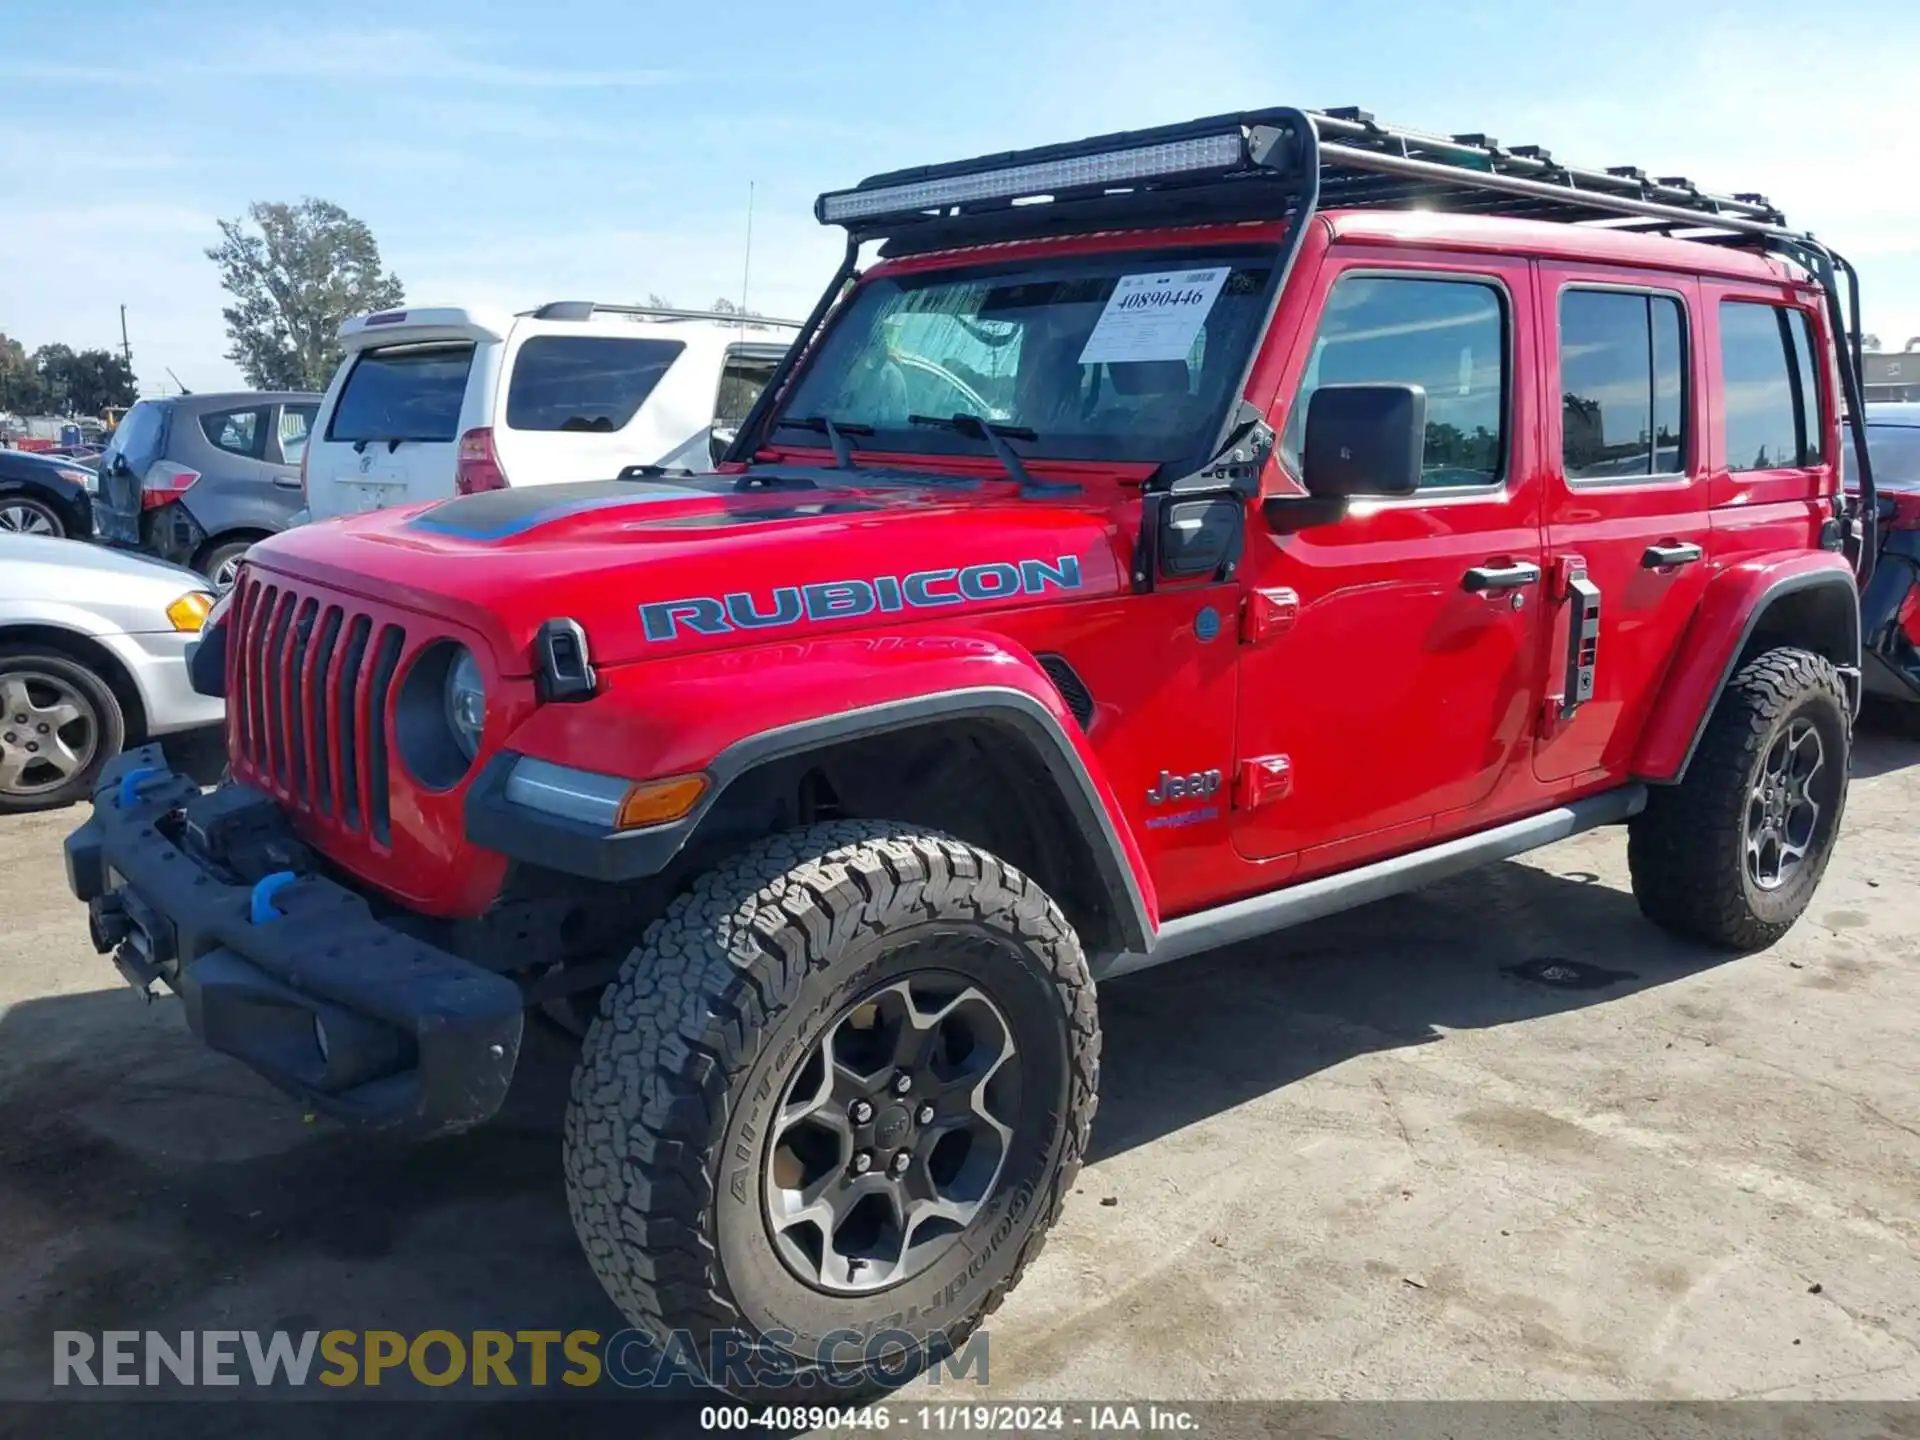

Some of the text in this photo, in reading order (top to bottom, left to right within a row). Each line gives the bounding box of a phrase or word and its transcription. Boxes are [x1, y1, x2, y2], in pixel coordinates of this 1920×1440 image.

[1117, 288, 1204, 310] 40890446
[638, 555, 1082, 642] RUBICON
[1146, 768, 1222, 805] Jeep
